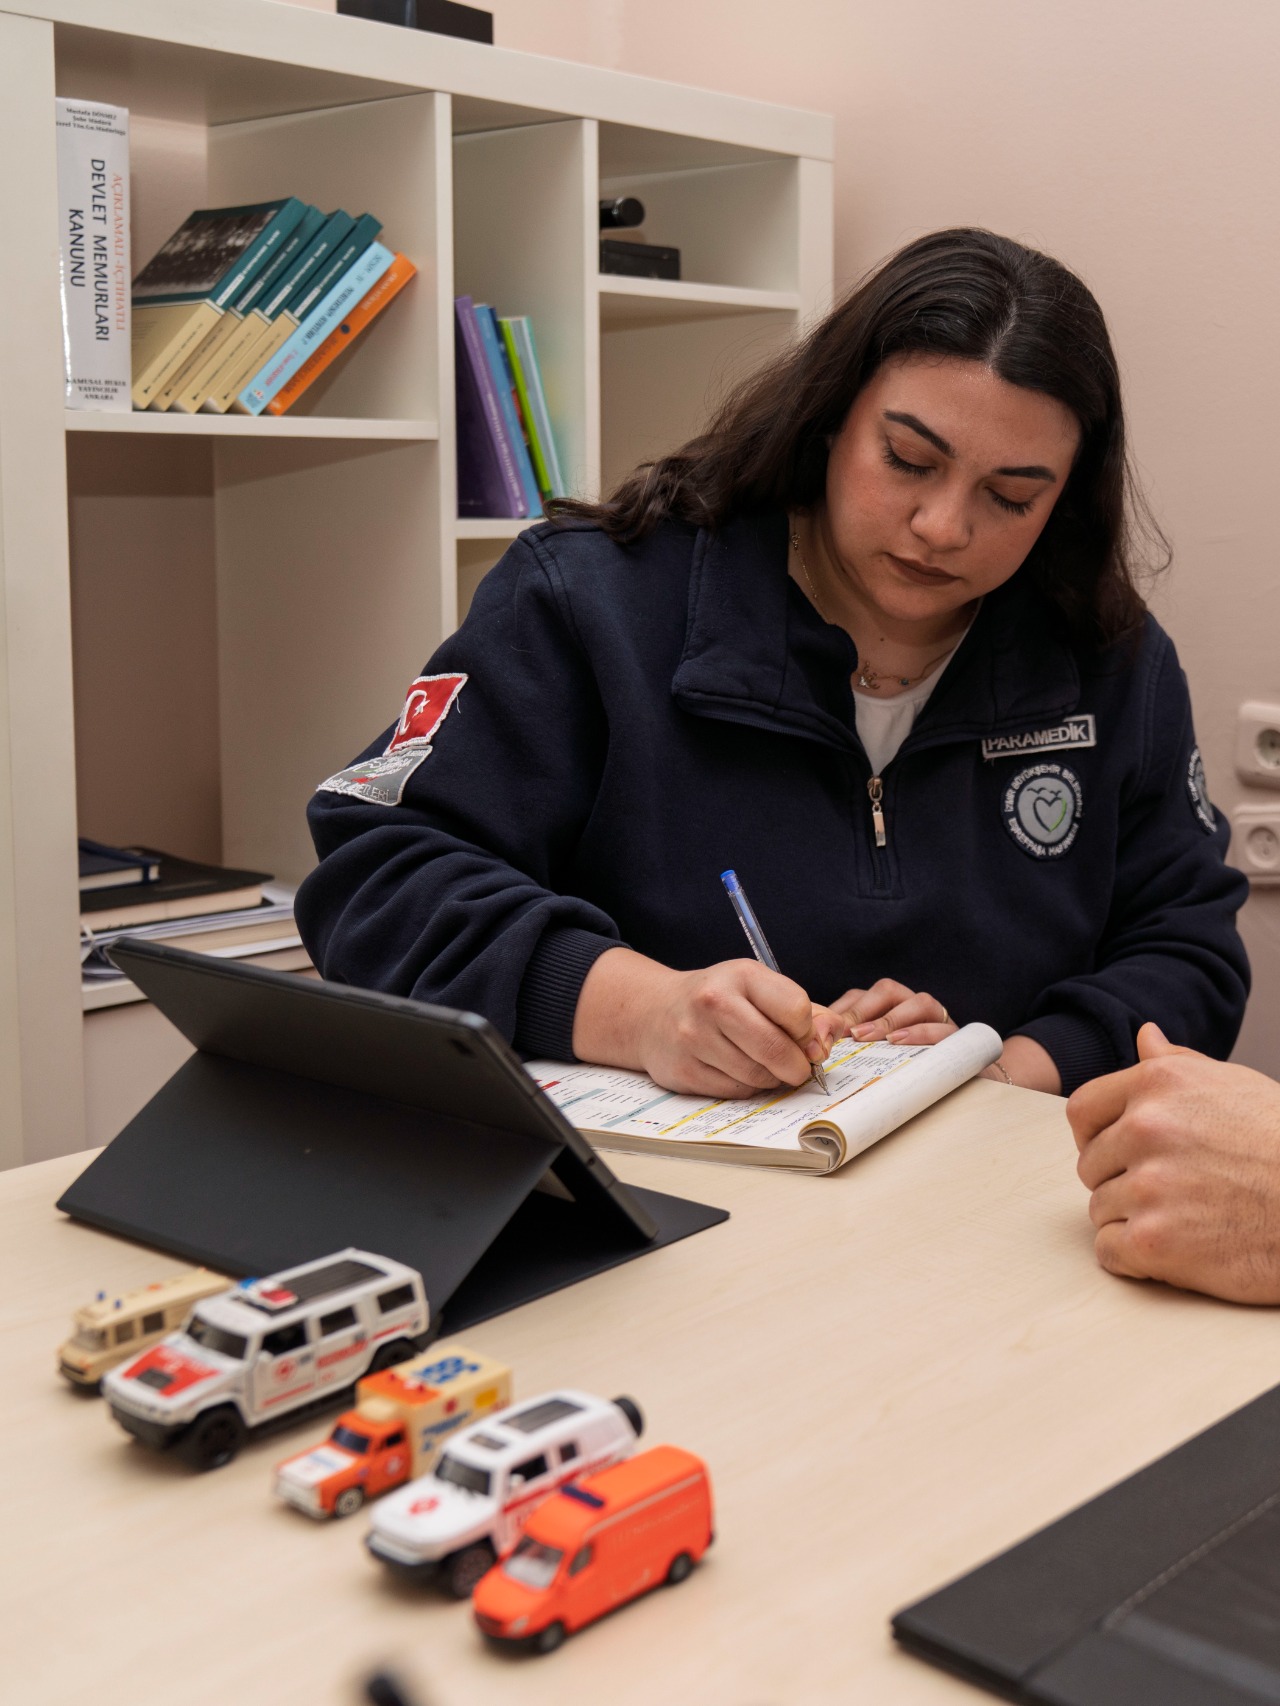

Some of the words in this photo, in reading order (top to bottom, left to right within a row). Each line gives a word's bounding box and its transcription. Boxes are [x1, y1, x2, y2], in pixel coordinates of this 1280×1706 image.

[91, 158, 107, 226] DEVLET
[111, 172, 124, 257] AÇIKLAMALI
[68, 208, 86, 288] KANUNU
[93, 234, 110, 341] MEMURLARI
[986, 722, 1090, 752] PARAMEDİK
